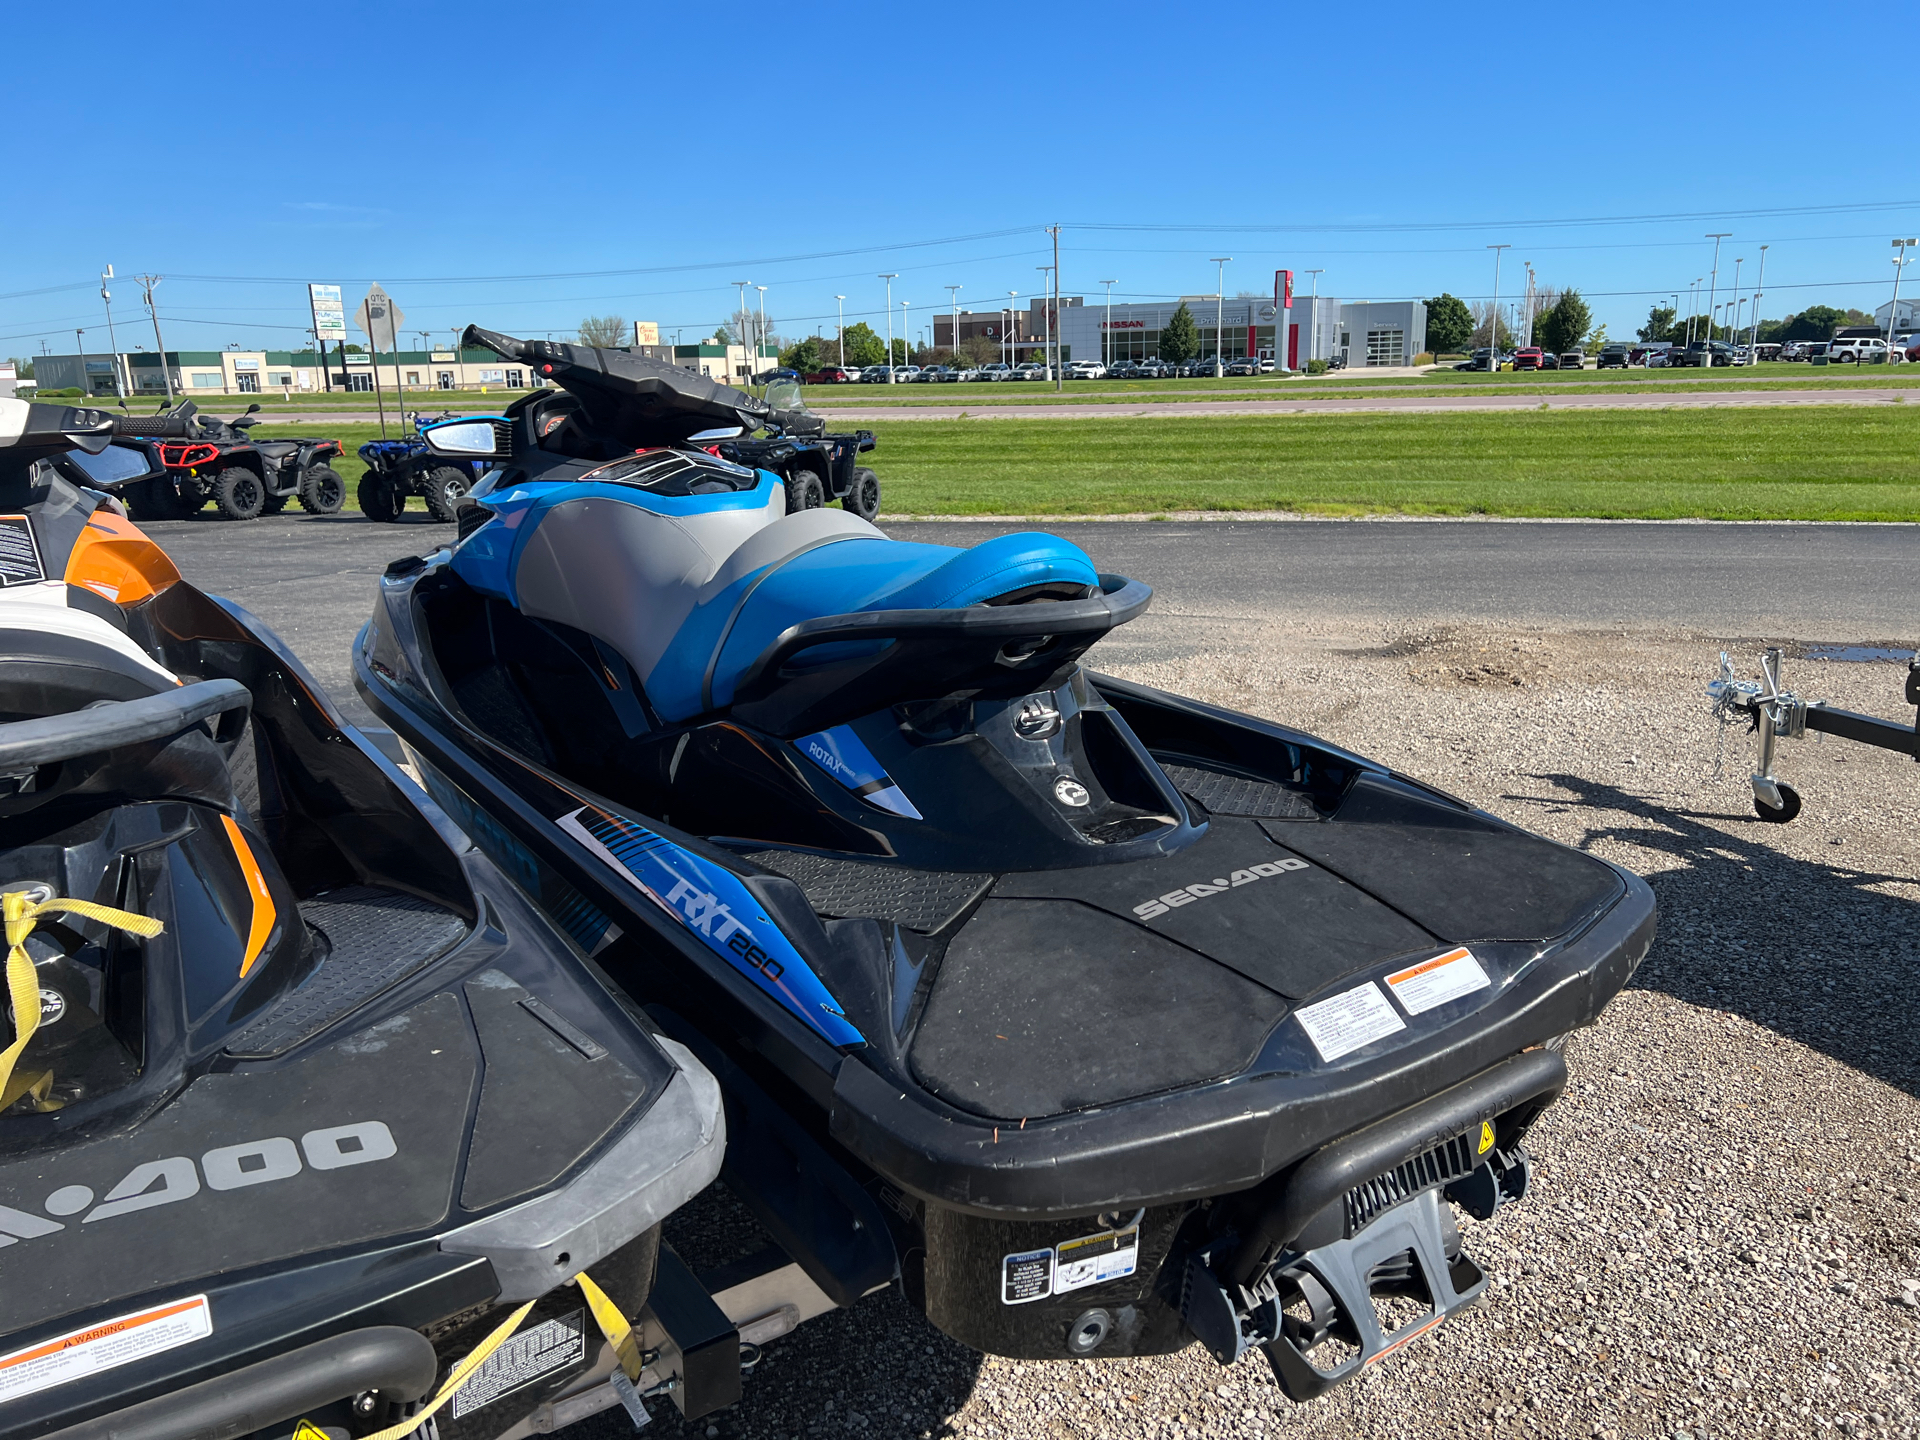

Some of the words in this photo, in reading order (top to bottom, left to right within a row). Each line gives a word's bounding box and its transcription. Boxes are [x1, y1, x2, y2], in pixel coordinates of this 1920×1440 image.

[1102, 320, 1145, 329] NISSAN
[809, 741, 842, 774] ROTAX
[1072, 790, 1087, 798] BRP
[665, 877, 752, 943] RXT
[728, 933, 785, 982] 260
[1016, 1253, 1040, 1261] NOTICE
[75, 1322, 125, 1344] WARNING
